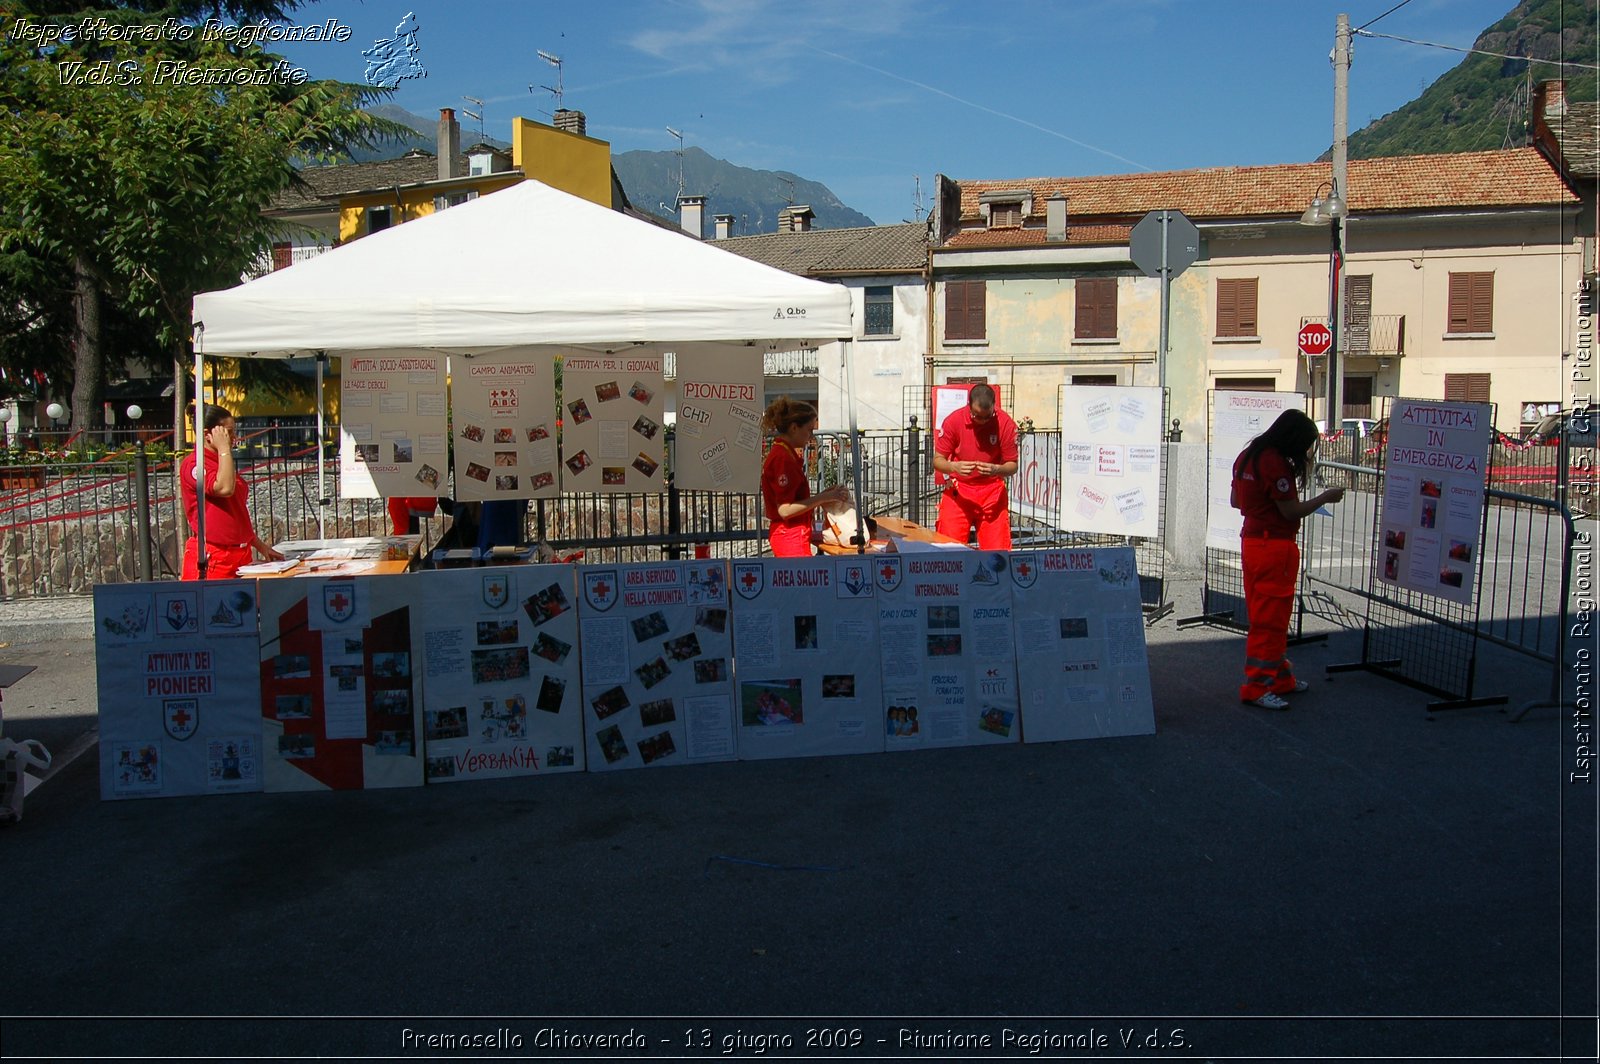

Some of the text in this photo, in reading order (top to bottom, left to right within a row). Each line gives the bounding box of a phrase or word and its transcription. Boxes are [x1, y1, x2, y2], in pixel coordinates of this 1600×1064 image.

[1300, 333, 1329, 345] STOP
[471, 366, 534, 375] CAMPO ANIMATORI
[603, 361, 616, 370] PER
[627, 361, 659, 371] GIOVANI
[684, 383, 754, 400] PIONIERI
[682, 406, 710, 423] CHI?
[1402, 405, 1477, 427] ATTIVITA'
[1427, 430, 1444, 447] IN
[702, 442, 726, 461] COME?
[1393, 448, 1478, 475] EMERGENZA
[909, 560, 963, 574] AREA COOPERAZIONE
[1043, 552, 1093, 571] AREA PACE
[626, 569, 677, 585] AREA SERVIZIO
[773, 569, 829, 587] AREA SALUTE
[624, 588, 686, 607] NELLA COMUNITA'
[914, 583, 960, 597] INTERNAZIONALE
[973, 607, 1010, 619] DEFINIZIONE
[147, 651, 211, 673] ATTIVITA' DEI
[147, 675, 212, 696] PIONIERI
